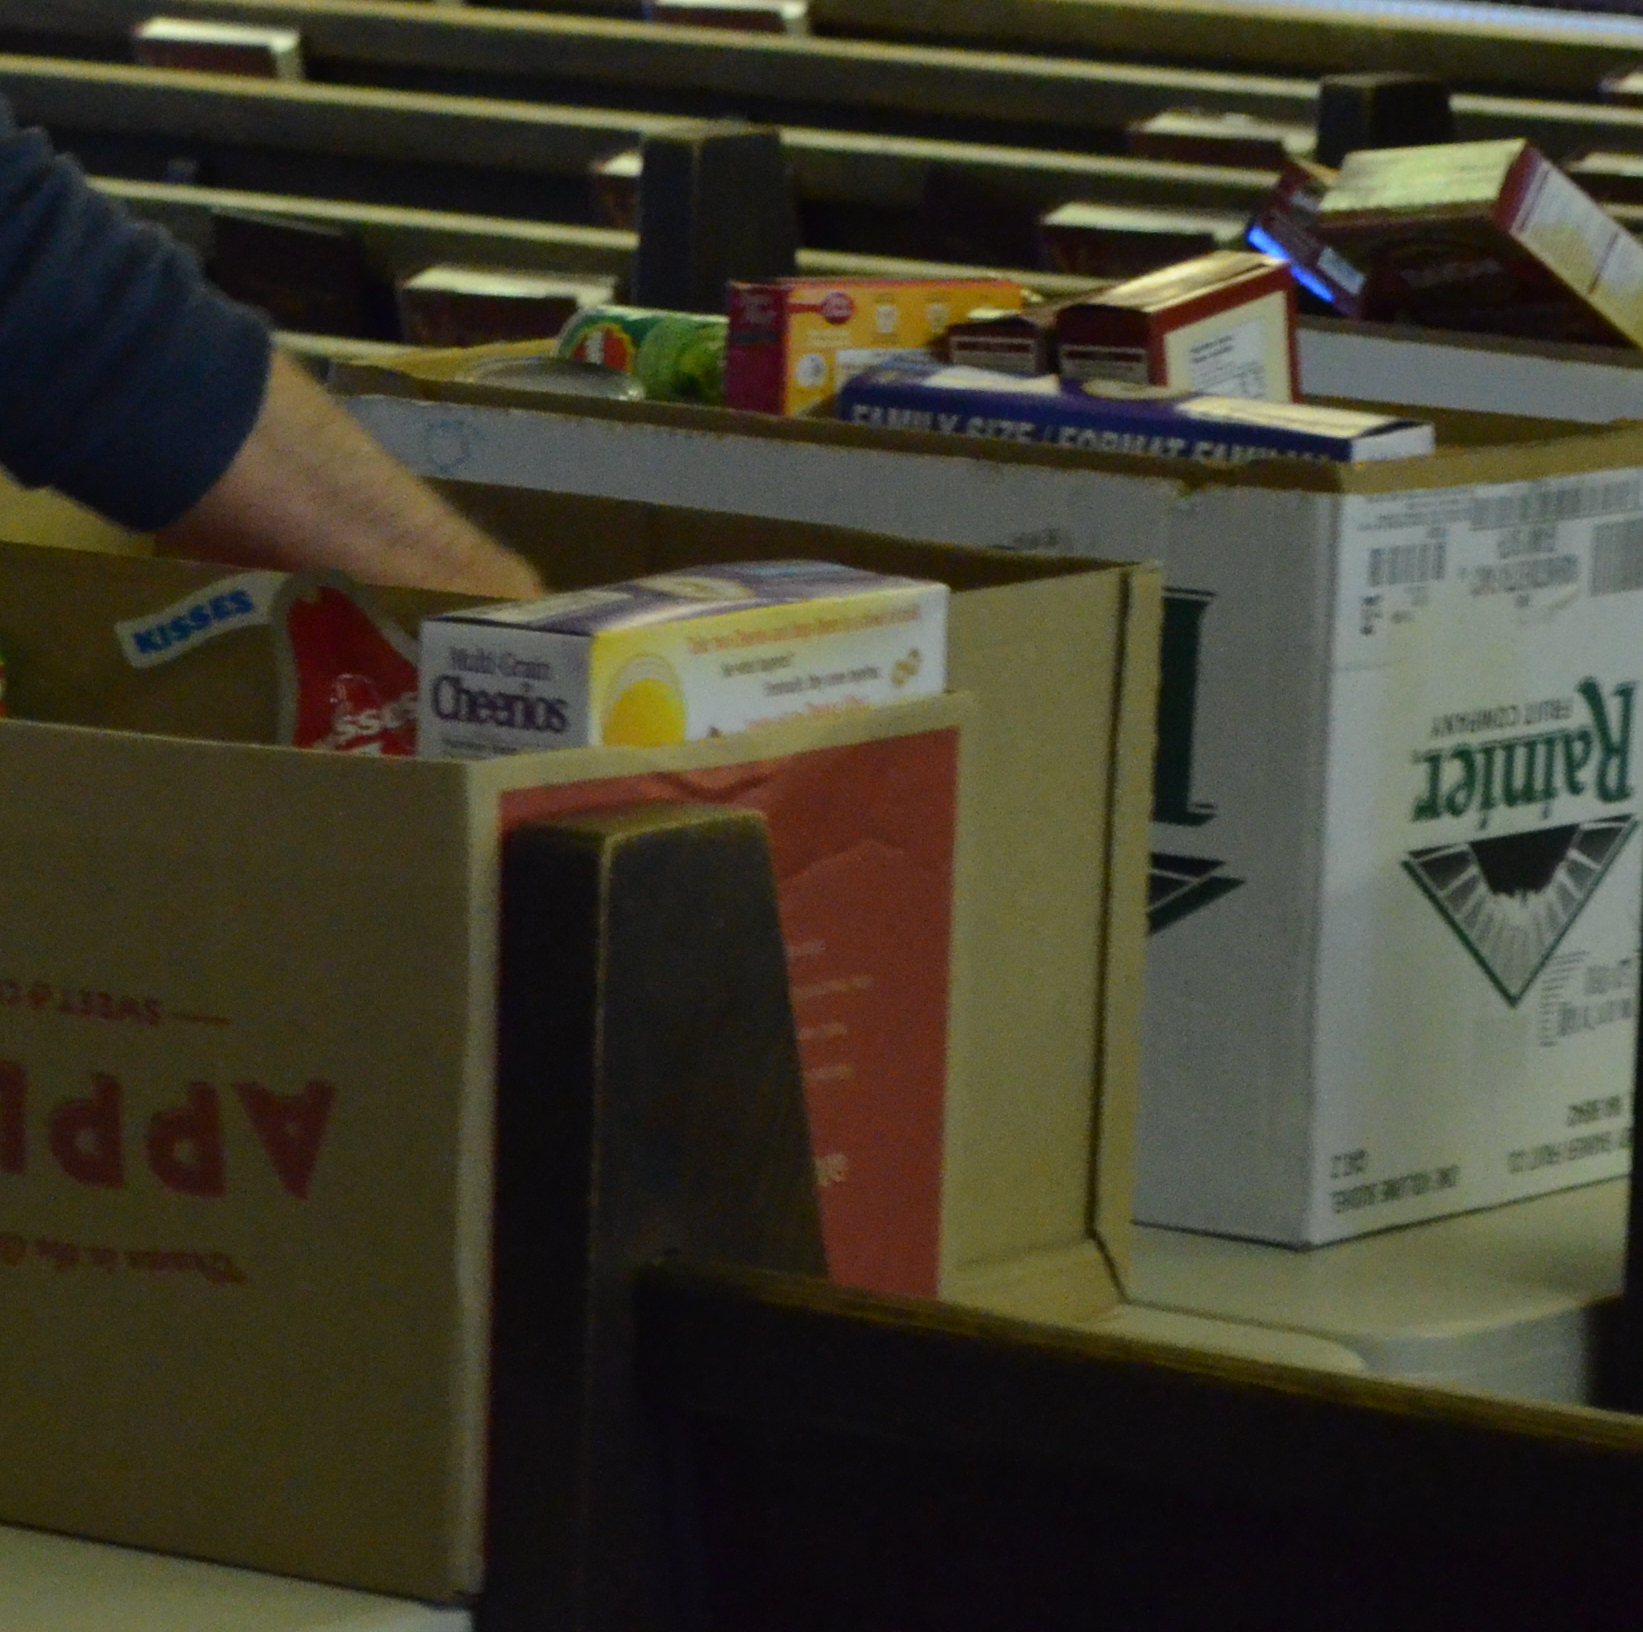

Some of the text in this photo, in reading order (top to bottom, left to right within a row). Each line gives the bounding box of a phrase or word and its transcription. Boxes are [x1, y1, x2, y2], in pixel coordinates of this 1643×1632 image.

[852, 403, 956, 436] FAMILY
[965, 416, 1033, 445] SIZE
[133, 588, 255, 653] KISSES
[431, 674, 569, 734] Cheerios
[1412, 675, 1640, 831] Rainier
